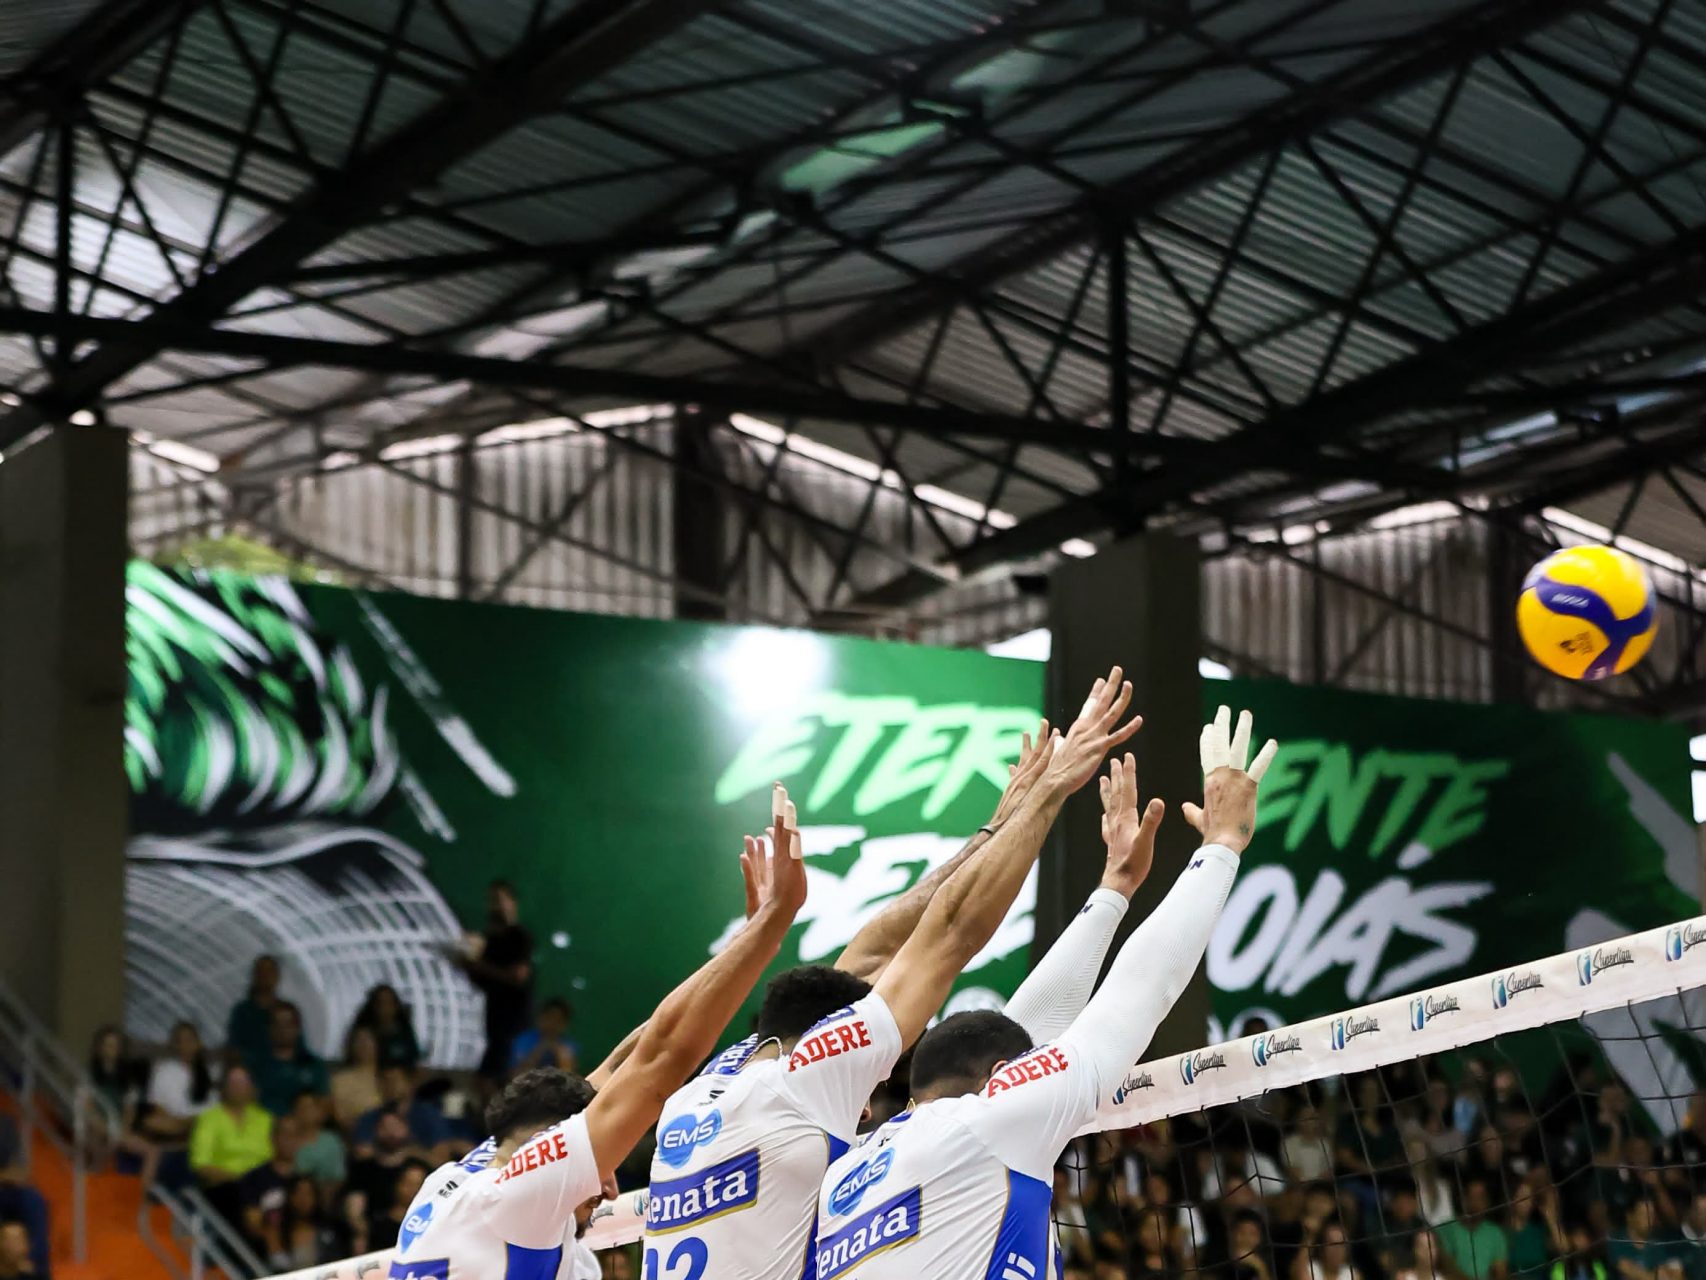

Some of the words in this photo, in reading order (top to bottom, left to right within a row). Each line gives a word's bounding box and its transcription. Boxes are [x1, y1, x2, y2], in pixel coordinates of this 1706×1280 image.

[1206, 842, 1496, 1002] OIÁS
[788, 1021, 872, 1073] ADERE
[987, 1047, 1069, 1098] ADERE
[663, 1119, 714, 1149] EMS
[646, 1168, 749, 1224] enata
[834, 1159, 888, 1203] EMS
[816, 1204, 910, 1280] enata
